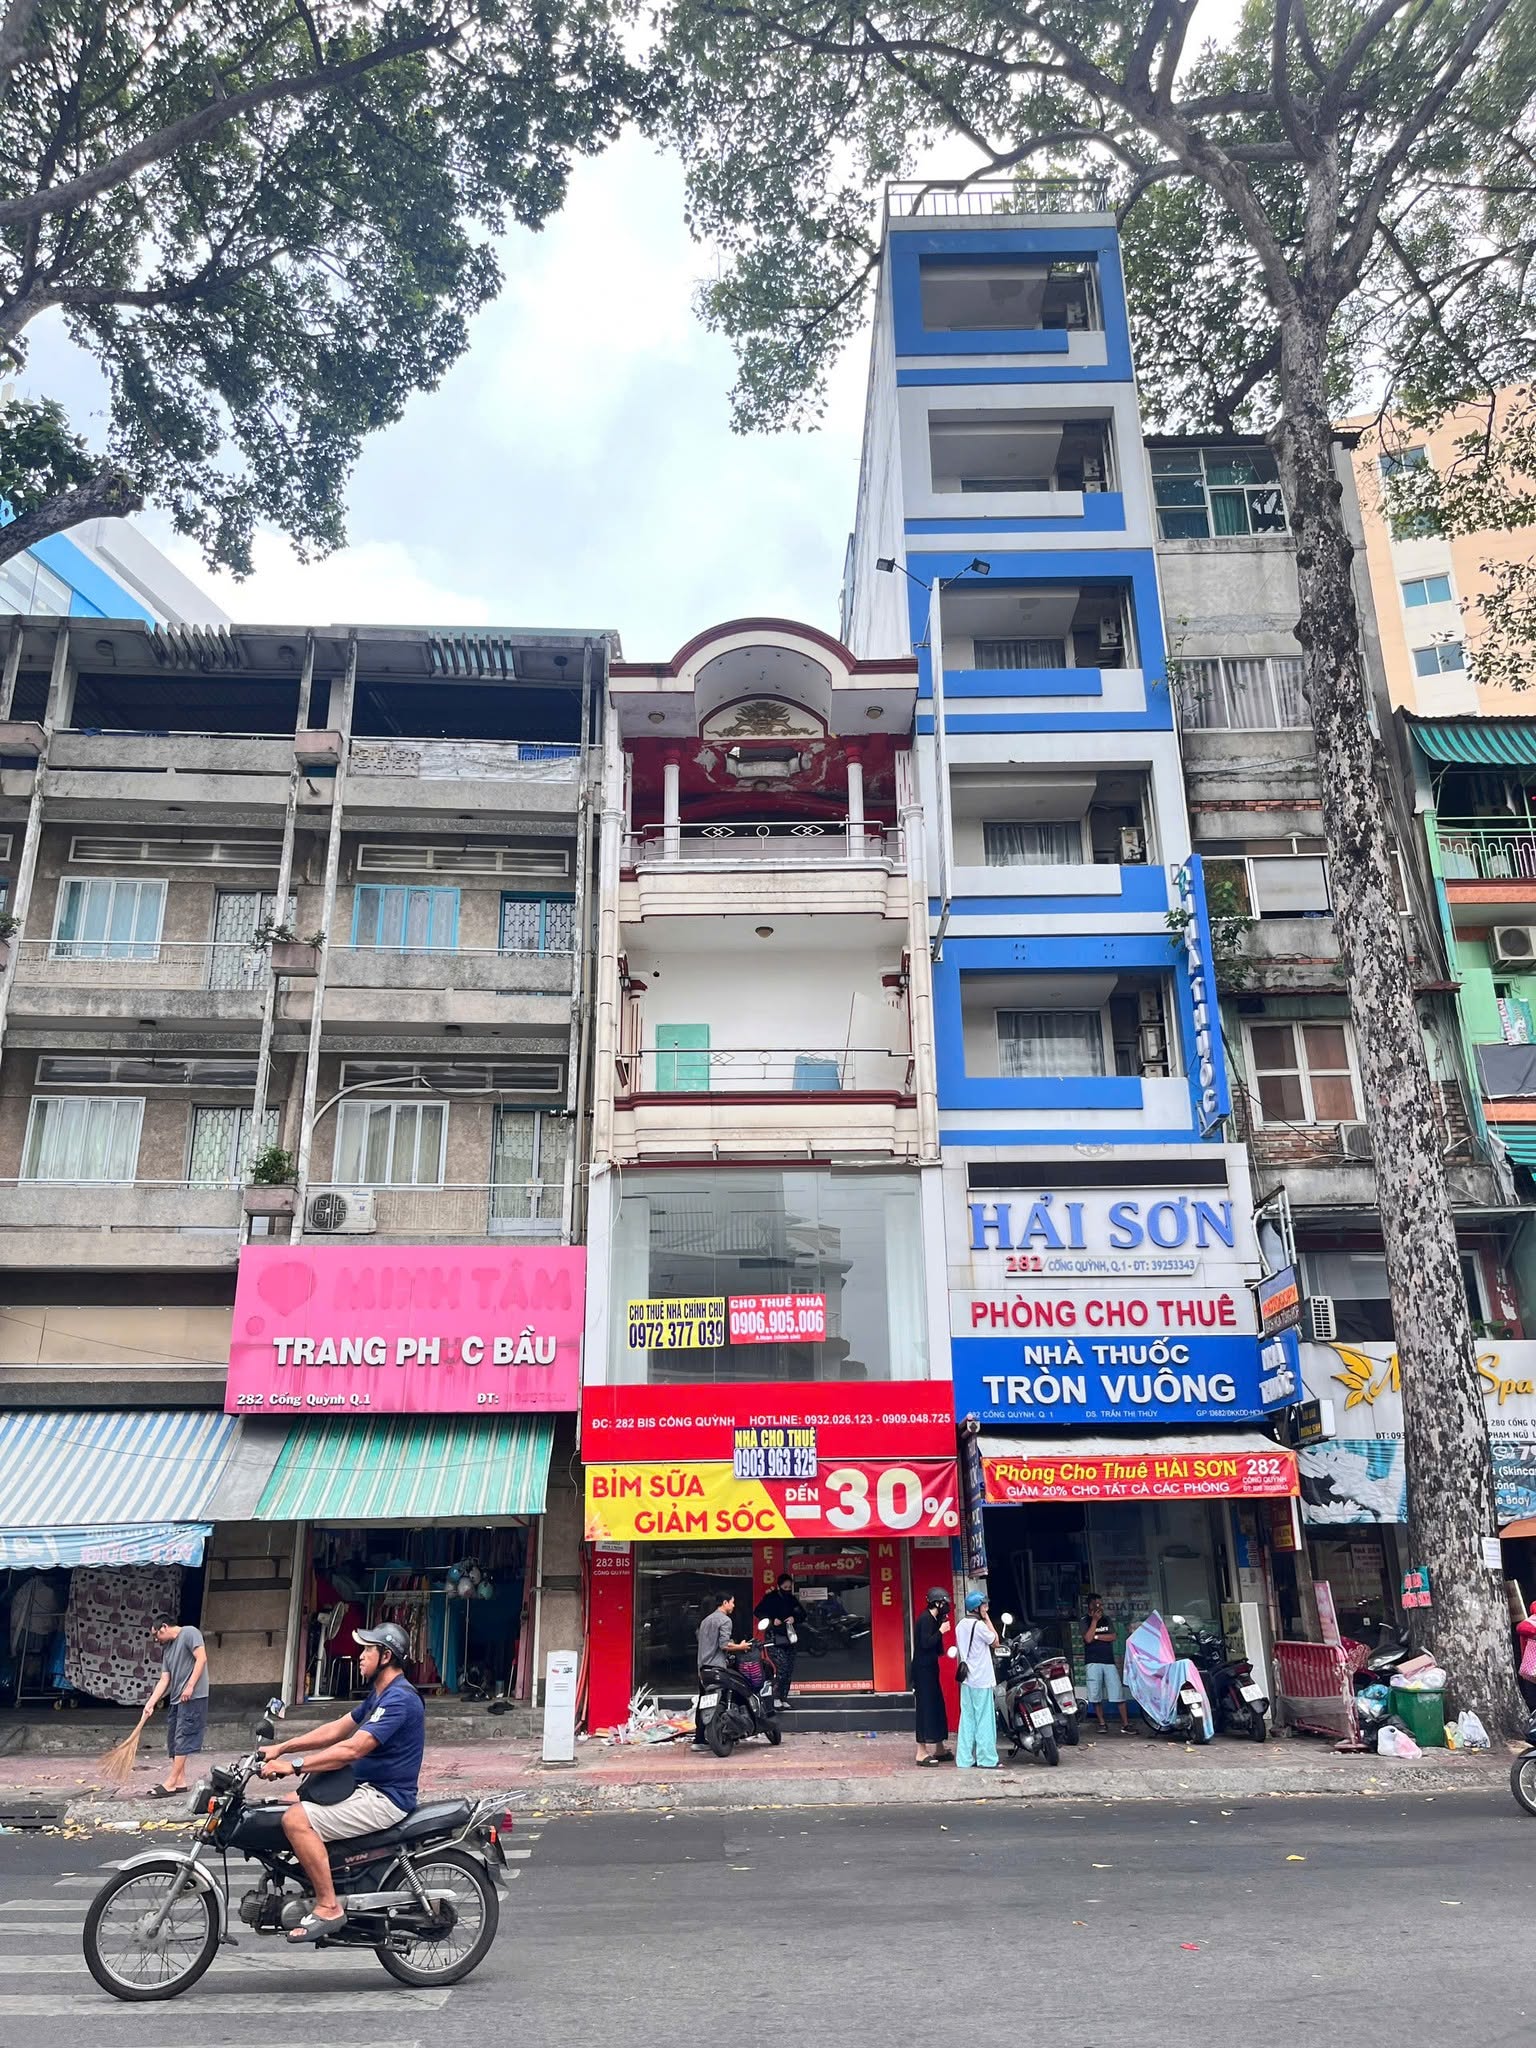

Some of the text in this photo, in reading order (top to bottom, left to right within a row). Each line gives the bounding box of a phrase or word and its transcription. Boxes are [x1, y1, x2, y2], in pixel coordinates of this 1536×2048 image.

[968, 1193, 1235, 1250] HẢI SƠN
[1005, 1255, 1043, 1272] 282
[1152, 1260, 1195, 1271] 39253343
[629, 1299, 723, 1320] CHO THUÊ NHÀ CHÍNH CHỦ
[730, 1296, 824, 1310] CHO THUÊ NHÀ
[971, 1294, 1076, 1328] PHÒNG
[1085, 1300, 1149, 1326] CHO
[1157, 1294, 1236, 1326] THUÊ
[731, 1310, 824, 1335] 0906.905.006
[273, 1336, 387, 1366] TRANG
[493, 1324, 557, 1366] BẦU
[629, 1320, 723, 1349] 0972 377 039
[1024, 1337, 1190, 1366] NHÀ THUỐC
[982, 1367, 1087, 1405] TRÒN
[1100, 1367, 1236, 1405] VUÔNG
[1476, 1353, 1534, 1406] Spa
[237, 1392, 371, 1407] 282 Cống Quỳnh Q.1
[477, 1393, 500, 1405] ĐT:
[592, 1418, 613, 1429] ĐC:
[615, 1417, 635, 1429] 282
[636, 1417, 657, 1428] BIS
[749, 1413, 802, 1426] HOTLINE:
[804, 1413, 873, 1426] 0932.026.123
[881, 1412, 951, 1425] 0909.048.725
[735, 1426, 816, 1448] NHÀ CHO THUÊ
[735, 1448, 816, 1477] 0903 963 325
[995, 1457, 1237, 1484] Phòng Cho Thuê HẢI SƠN
[1246, 1459, 1280, 1475] 282
[592, 1468, 705, 1499] BỈM SỮA
[785, 1483, 820, 1502] ĐẾN
[1006, 1480, 1230, 1497] GIẢM 20% CHO TẤT CẢ CÁC PHÒNG
[634, 1500, 776, 1534] GIẢM SỐC
[596, 1558, 630, 1567] 282 BIS
